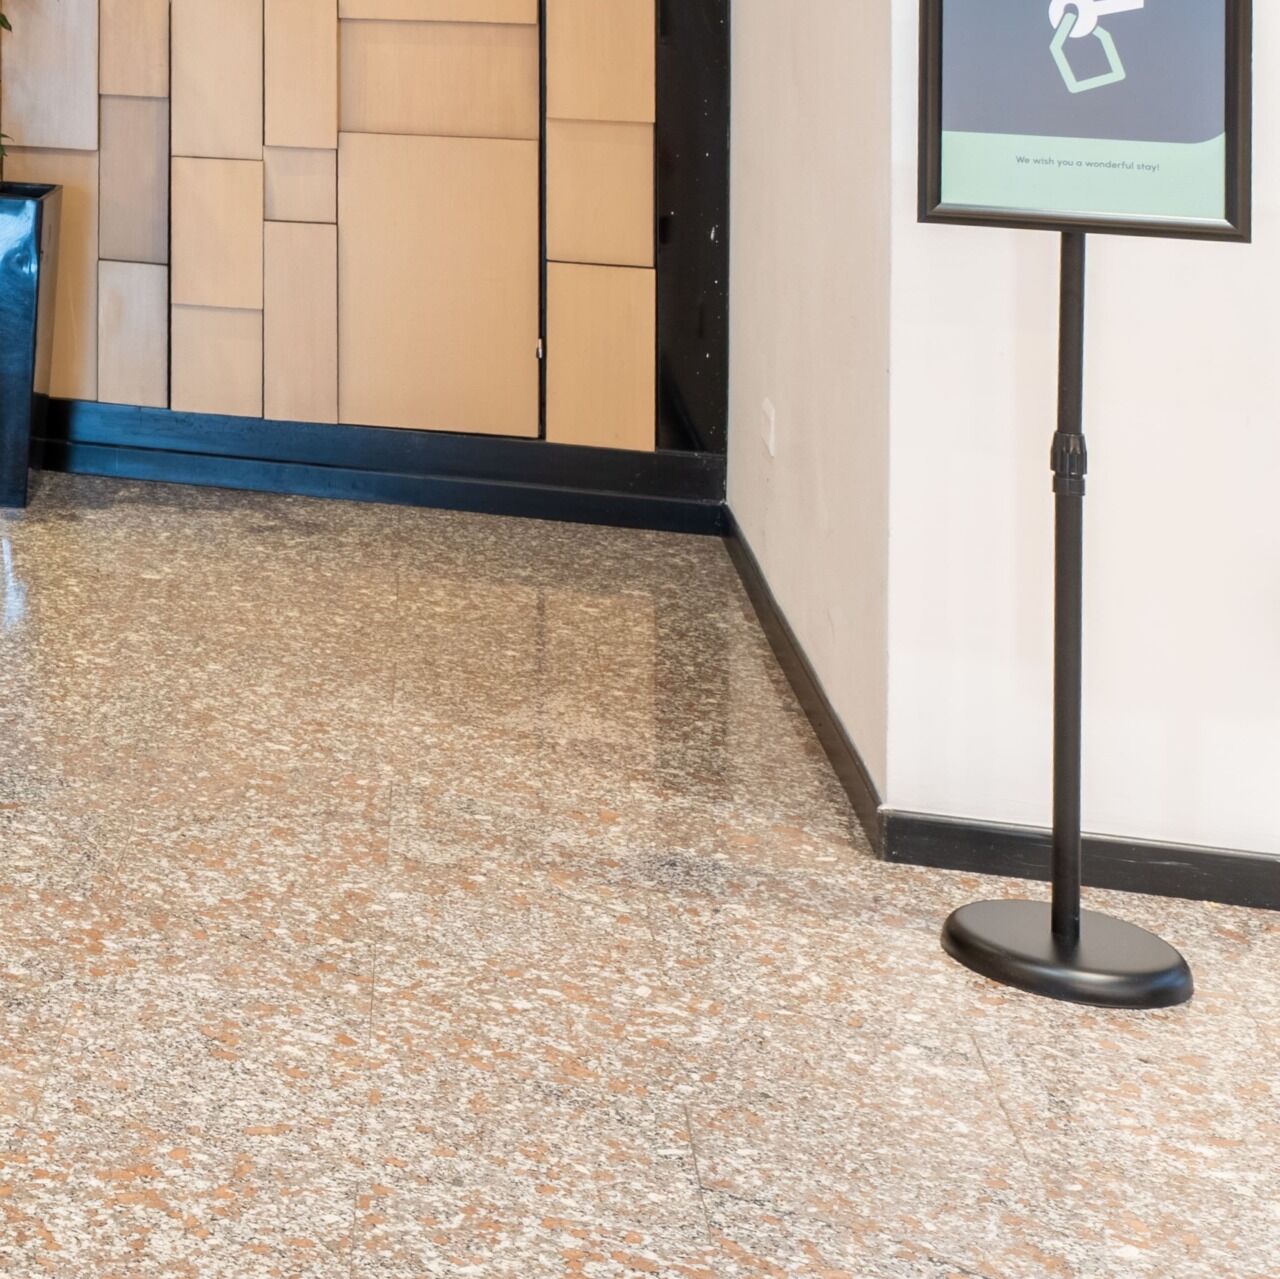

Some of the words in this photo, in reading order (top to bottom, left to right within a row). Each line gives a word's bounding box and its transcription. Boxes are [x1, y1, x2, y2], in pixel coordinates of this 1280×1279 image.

[1015, 155, 1030, 164] We
[1032, 156, 1055, 166] wish
[1057, 158, 1074, 167] you
[1085, 160, 1135, 170] wonderful
[1136, 163, 1160, 173] stay!
